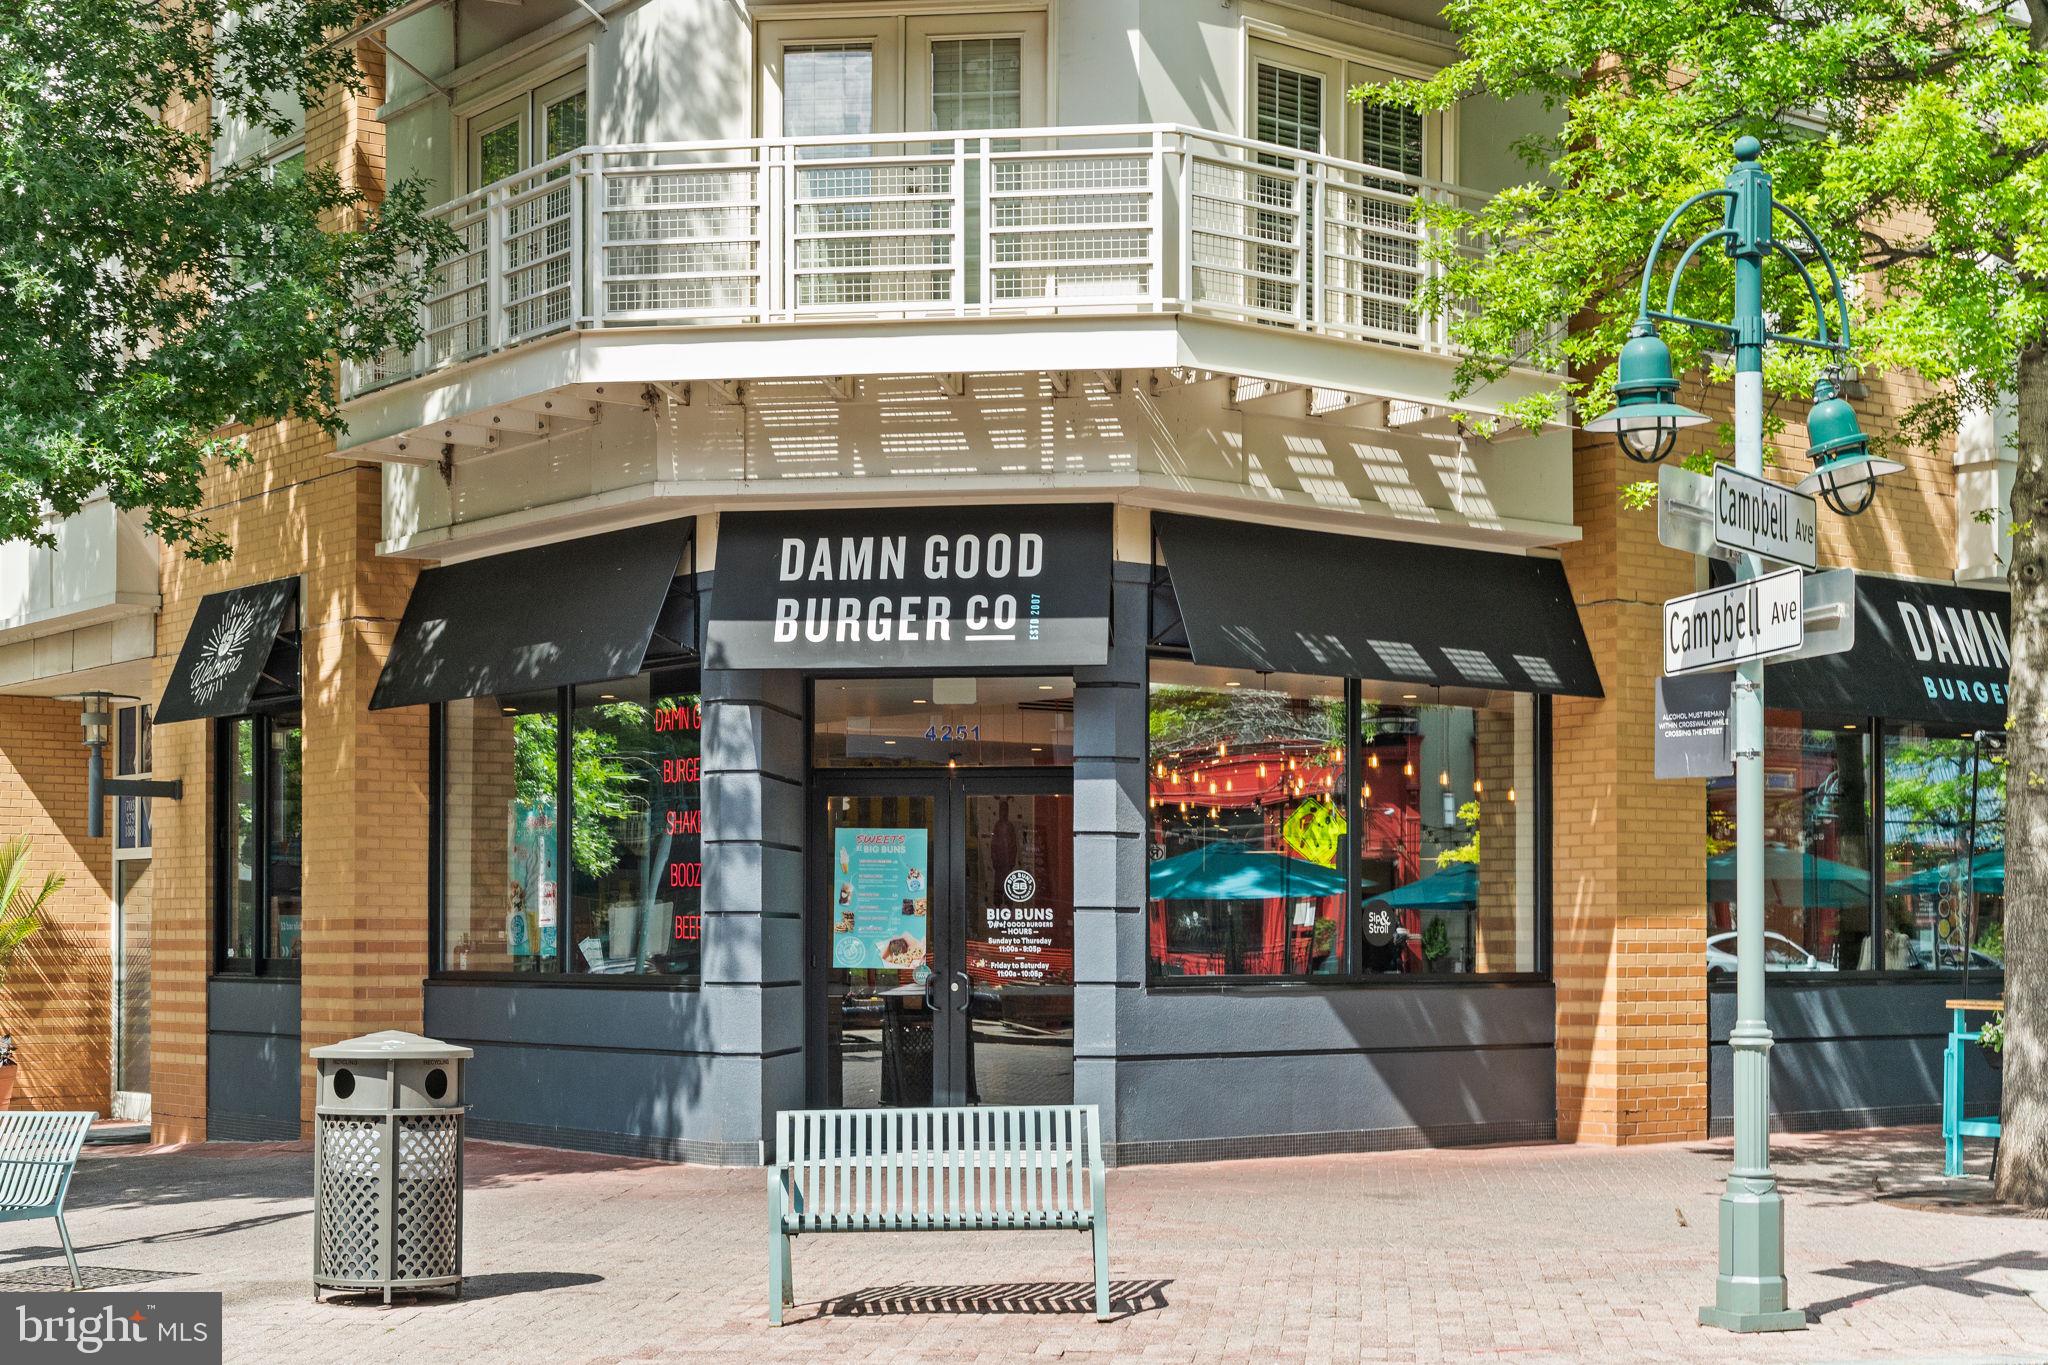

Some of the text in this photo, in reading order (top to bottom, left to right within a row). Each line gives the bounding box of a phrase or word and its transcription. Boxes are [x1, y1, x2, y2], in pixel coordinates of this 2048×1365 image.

[1719, 477, 1814, 547] Campbell Ave
[779, 533, 1044, 582] DAMN GOOD
[1030, 593, 1041, 616] 2007
[773, 593, 1017, 643] BURGER CO
[1670, 587, 1797, 658] Campbell Ave
[1897, 600, 2011, 669] DAMN
[1922, 676, 2010, 705] BURGE
[655, 707, 690, 733] DAMN
[1662, 710, 1725, 721] ALCOHOL MUST REMAIN
[1658, 718, 1729, 730] WITHIN CROSSWALK WHILE
[923, 724, 980, 742] 4251
[1664, 727, 1723, 738] CROSSING THE STREET
[856, 834, 905, 845] SWEETS
[864, 845, 880, 854] BIG
[881, 845, 906, 854] BUNS
[986, 908, 1054, 920] BIG BUNS
[1368, 923, 1389, 934] Stroll
[988, 937, 1012, 946] Sunday
[1021, 937, 1052, 946] Thursday
[990, 962, 1011, 971] Friday
[1020, 962, 1050, 971] Saturday
